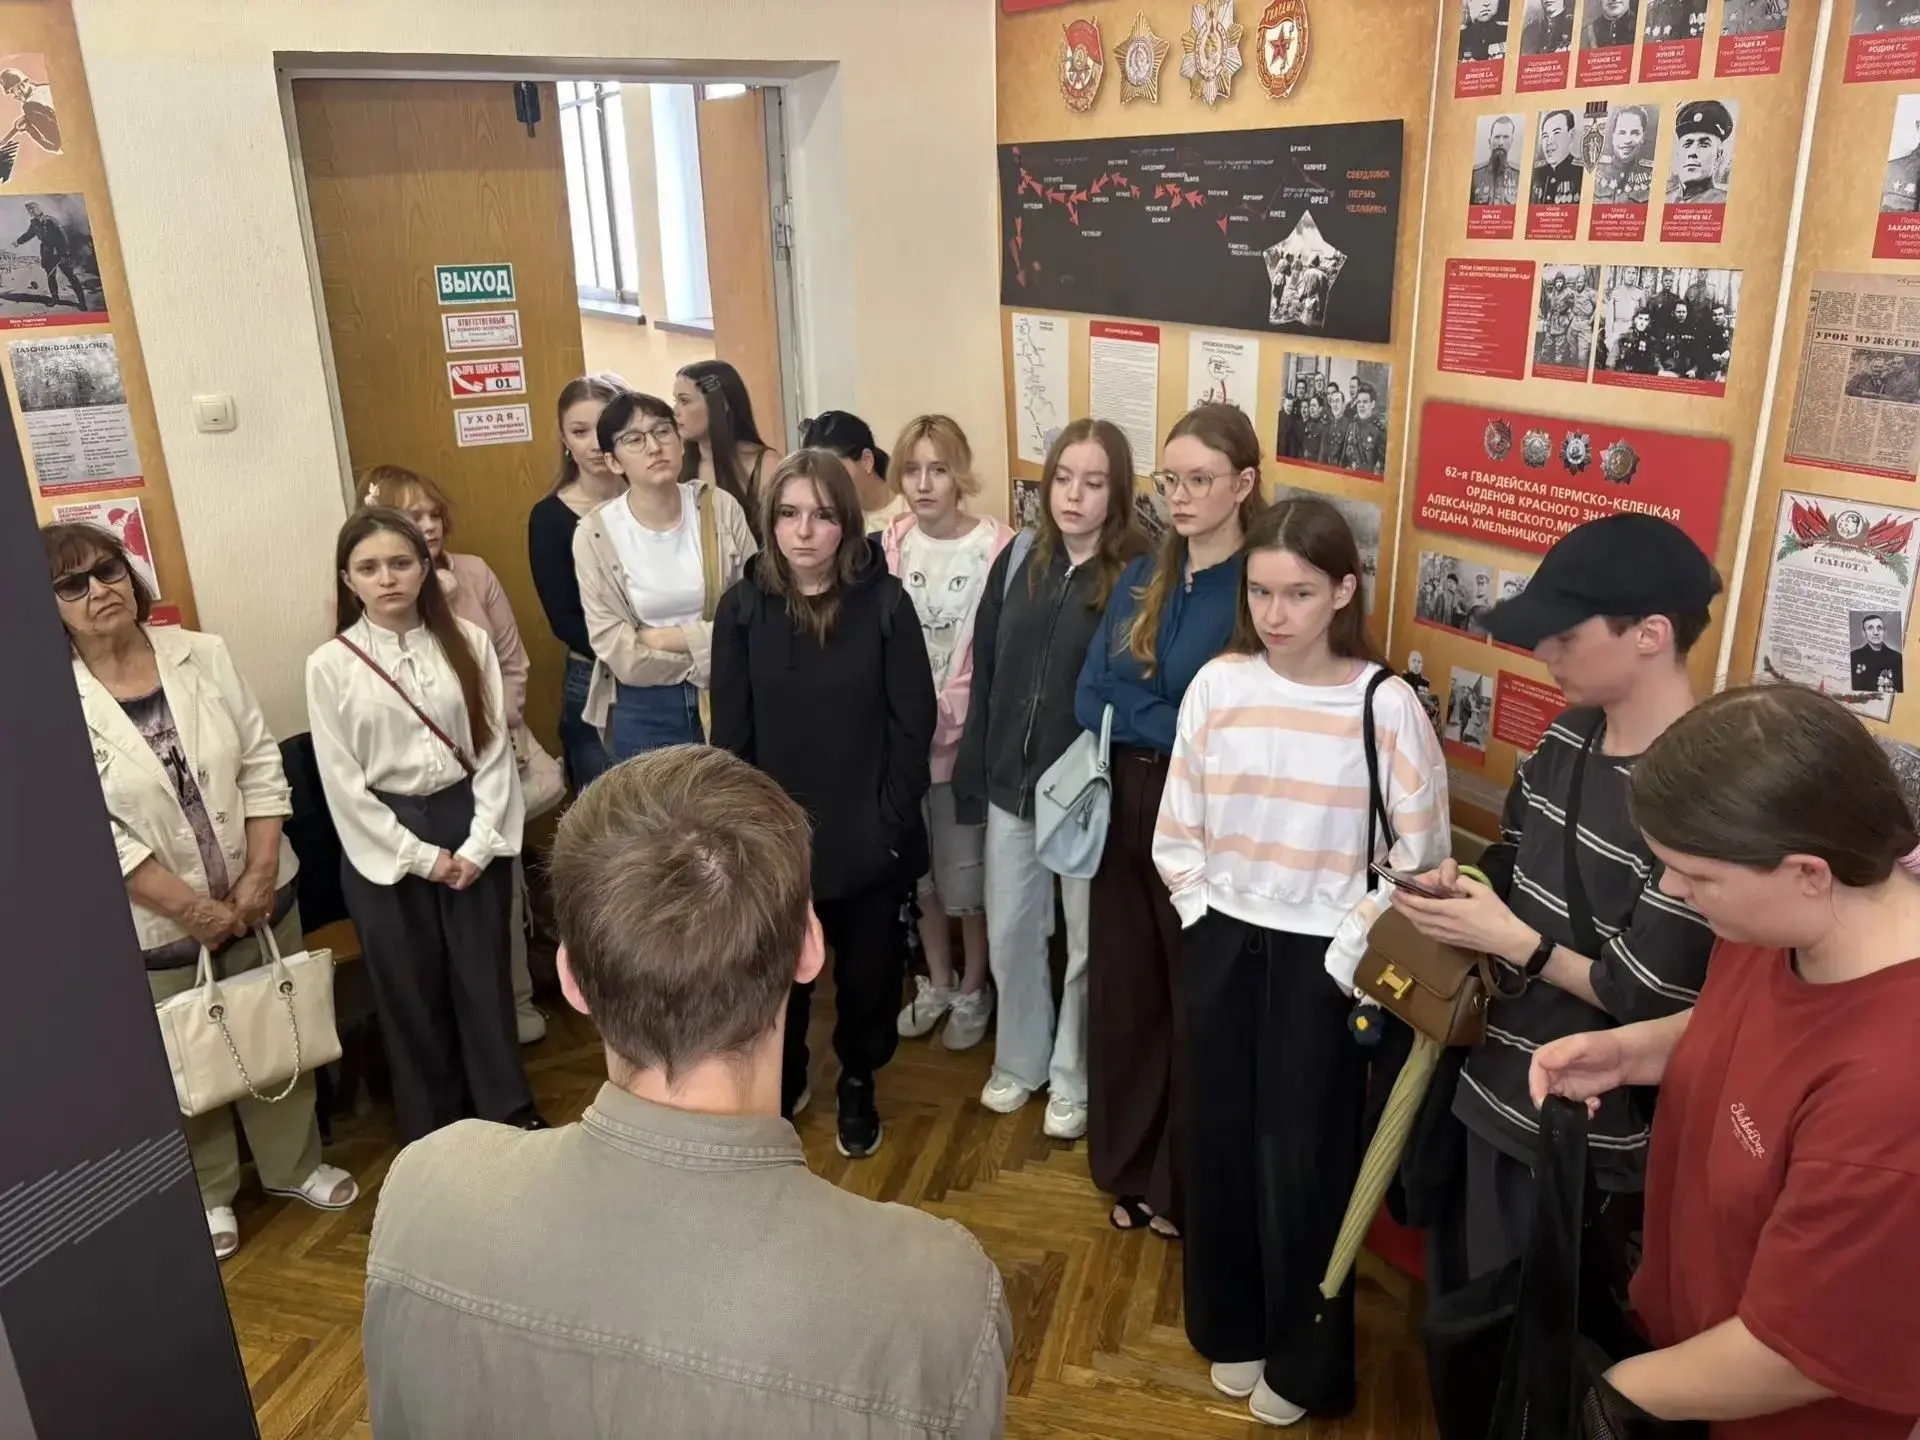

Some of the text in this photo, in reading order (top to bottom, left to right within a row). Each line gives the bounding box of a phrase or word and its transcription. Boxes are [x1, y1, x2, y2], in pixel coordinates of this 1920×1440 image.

[440, 269, 511, 295] ВЫХОД
[1815, 331, 1849, 342] УРОК
[495, 378, 512, 389] 01
[1444, 466, 1681, 521] 62-я ГВАРДЕЙСКАЯ ПЕРМСКО-КЕЛЕЦКАЯ
[1466, 486, 1516, 505] ОРДЕНОВ
[1518, 495, 1580, 518] КРАСНОГО
[1427, 493, 1494, 517] АЛЕКСАНДРА
[1421, 506, 1469, 527] БОГДАНА
[1814, 555, 1868, 573] ГРАМОТА
